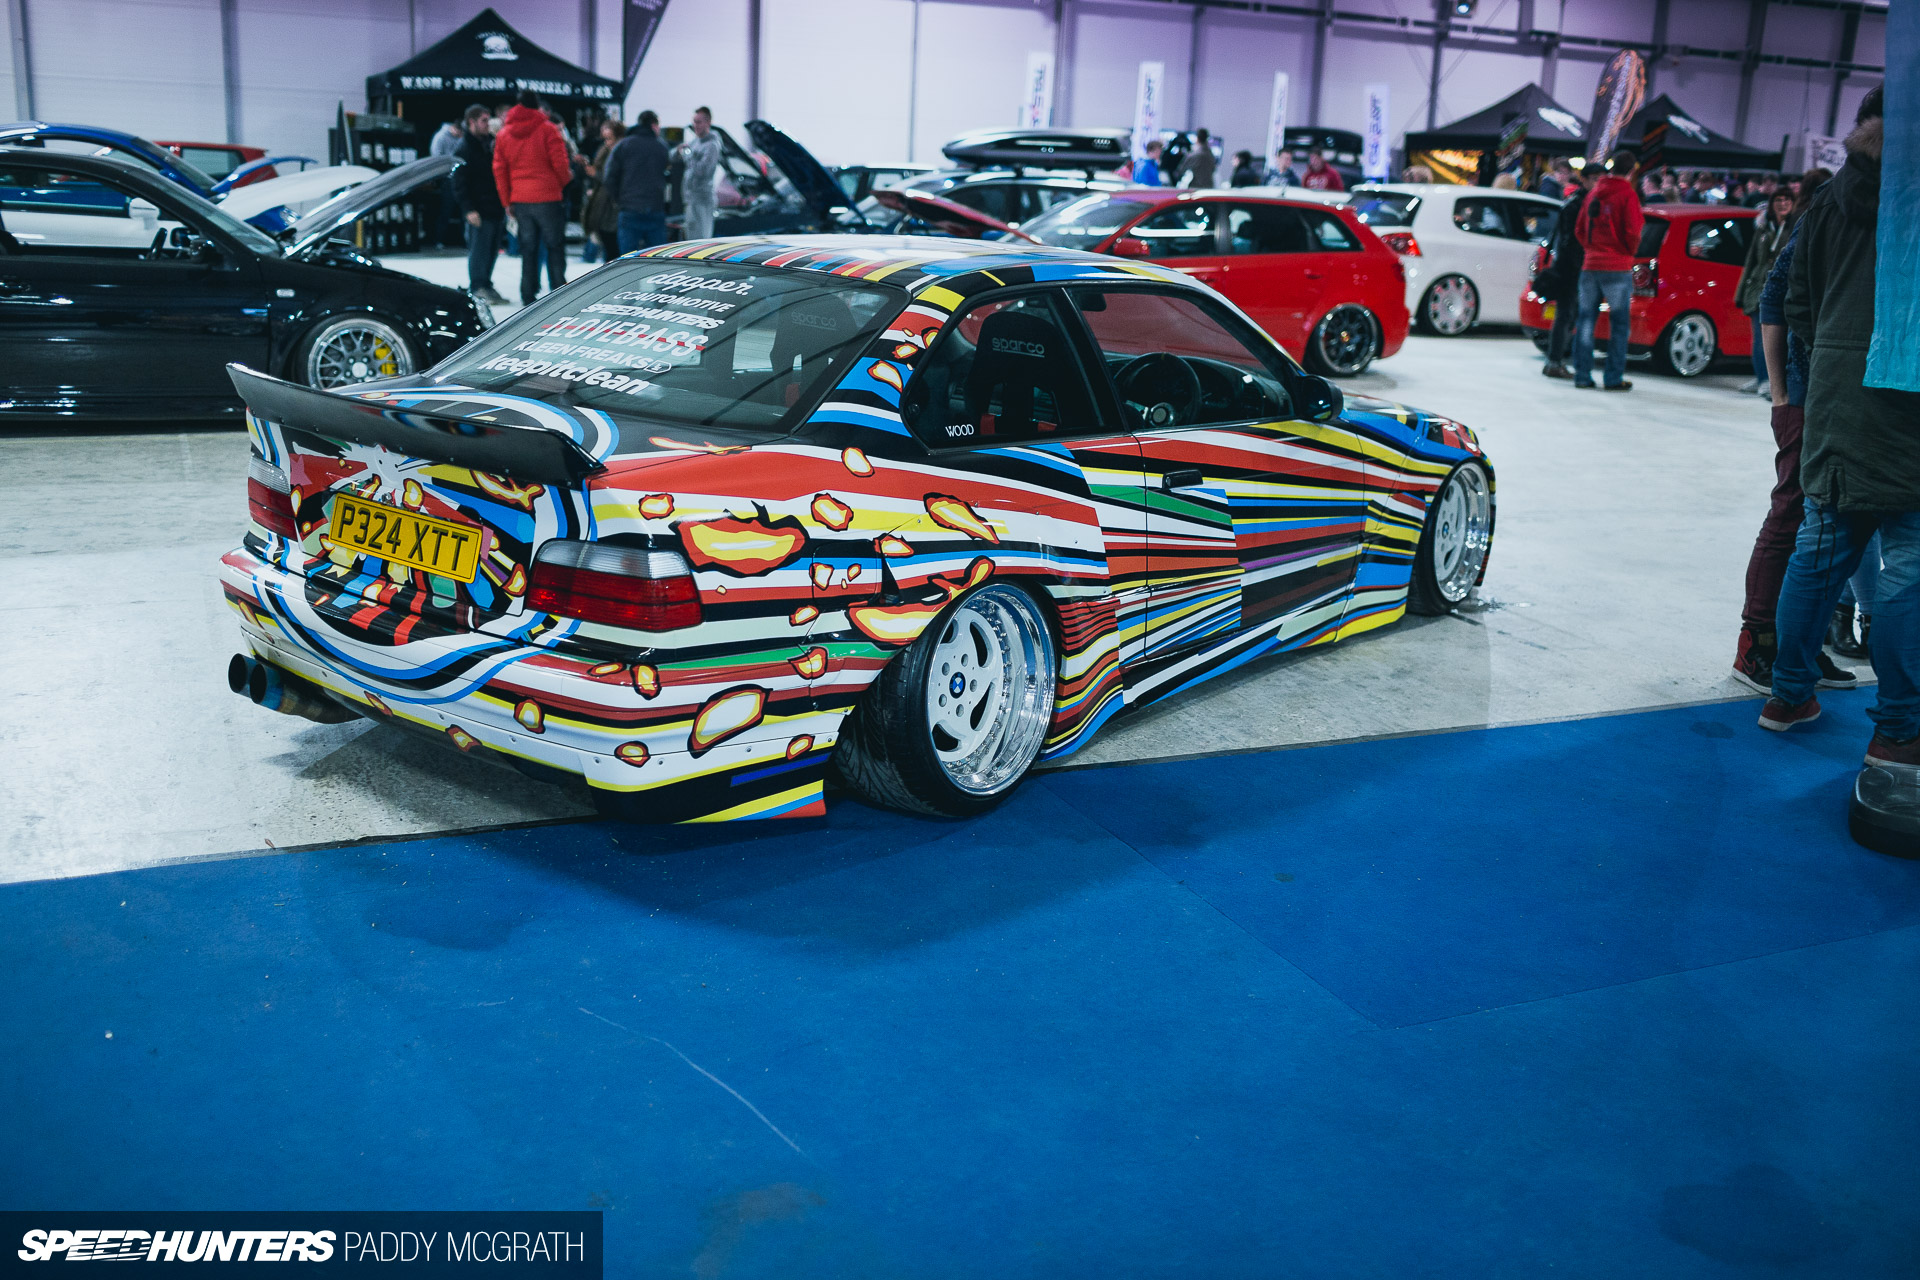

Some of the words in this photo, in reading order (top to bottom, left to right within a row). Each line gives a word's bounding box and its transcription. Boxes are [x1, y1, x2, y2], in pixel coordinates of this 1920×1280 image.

[613, 291, 735, 313] CCAUTOMOTIVE
[580, 303, 726, 330] SPEEDHUNTERS
[512, 340, 654, 369] KLEENFREAKS
[992, 336, 1045, 355] sparco
[477, 353, 655, 395] keepitclean
[945, 423, 975, 438] WOOD
[338, 503, 402, 554] P324
[408, 521, 469, 571] XTT
